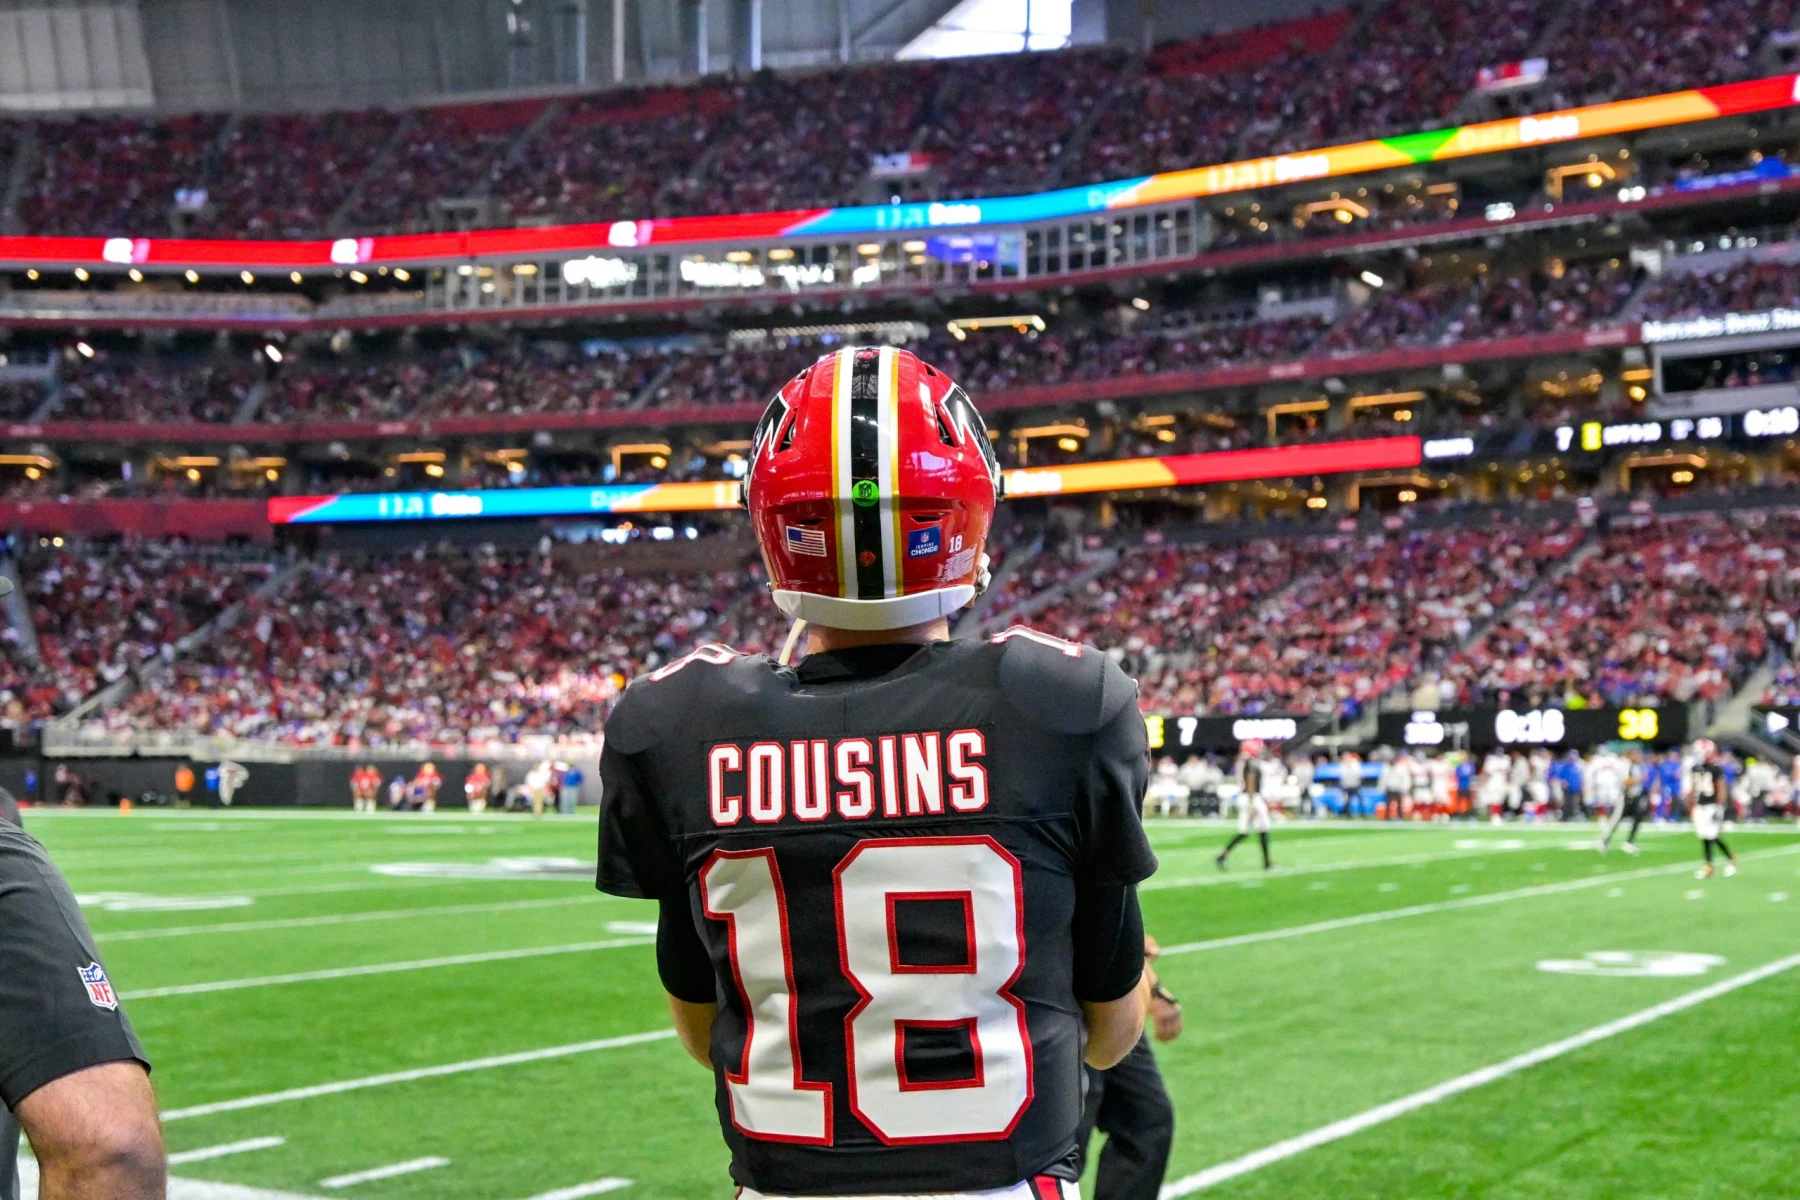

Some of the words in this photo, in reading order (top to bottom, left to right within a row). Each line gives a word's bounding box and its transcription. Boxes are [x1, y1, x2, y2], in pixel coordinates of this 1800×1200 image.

[949, 534, 963, 553] 18
[1177, 716, 1198, 746] 7
[708, 728, 989, 826] COUSINS
[698, 834, 1035, 1147] 18
